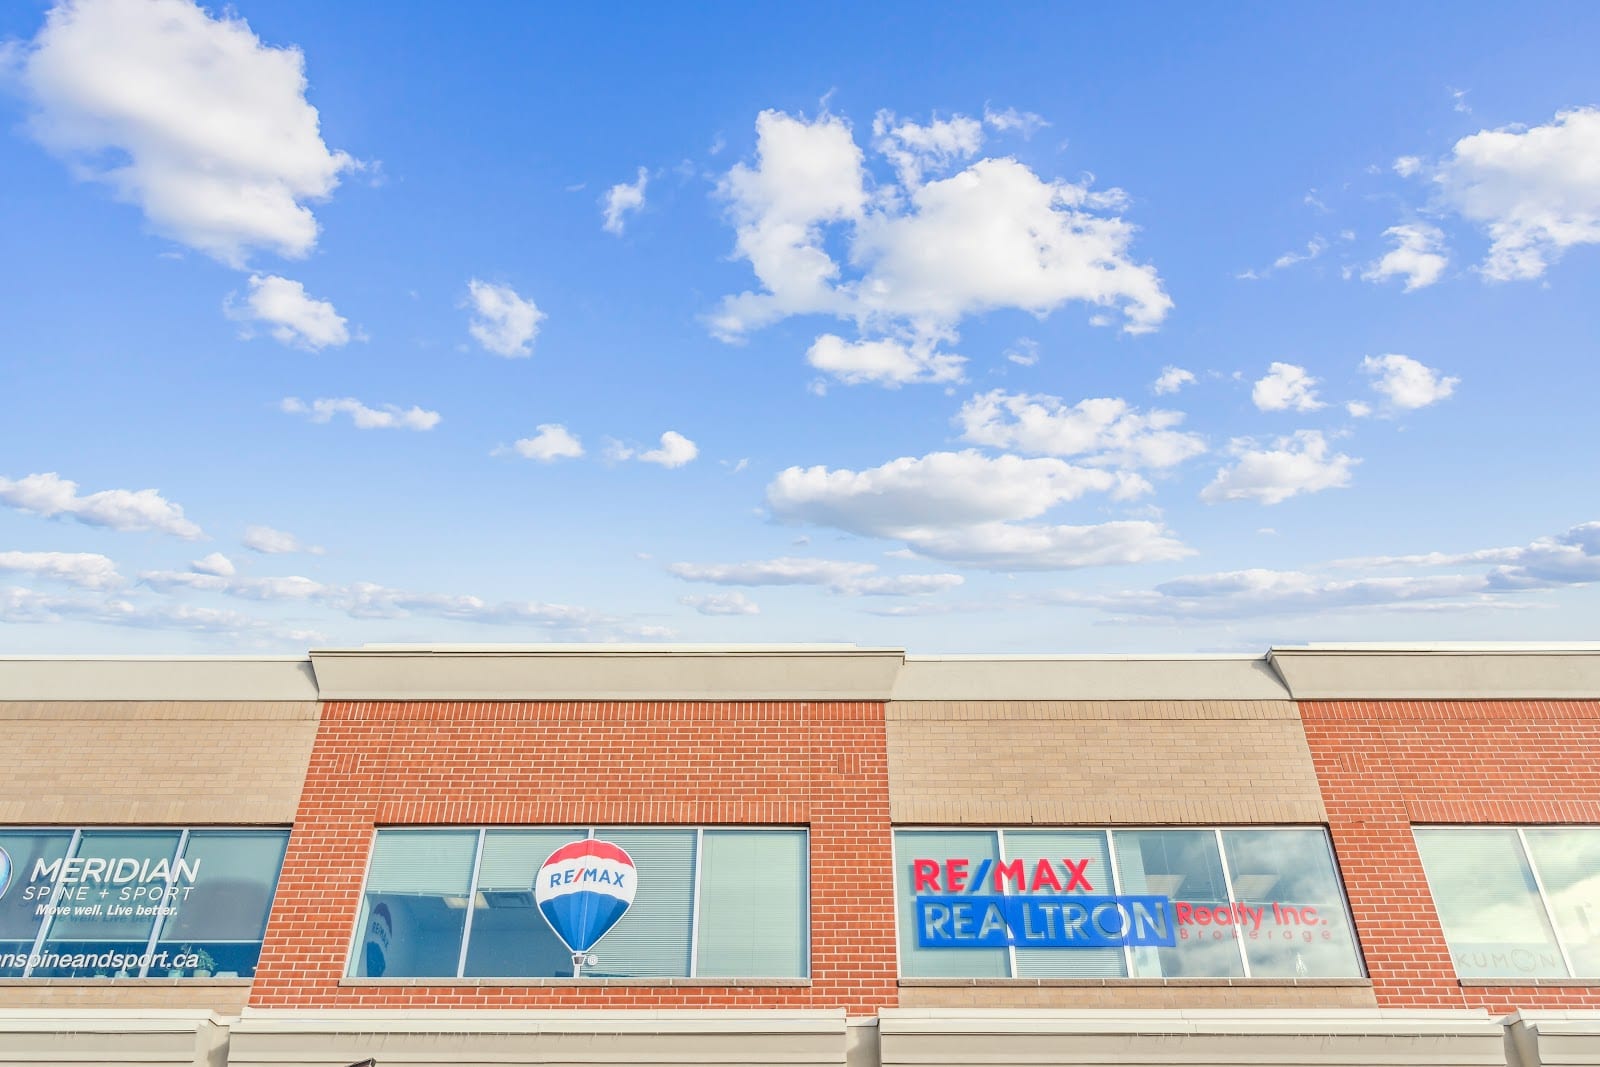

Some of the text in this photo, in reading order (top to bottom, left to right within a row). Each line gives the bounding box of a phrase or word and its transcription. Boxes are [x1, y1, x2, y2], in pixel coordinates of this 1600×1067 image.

[30, 857, 201, 883] MERIDIAN
[550, 868, 625, 888] RE/MAX
[913, 858, 1094, 893] RE/MAX
[22, 886, 90, 901] SPNE
[119, 886, 195, 901] SPORT
[35, 904, 178, 916] Move well. Live better.
[924, 902, 1169, 940] REALTRON
[1175, 901, 1329, 931] Realty Inc.
[1179, 928, 1332, 943] Brokerage
[0, 949, 199, 975] nspineandsport.ca
[1456, 949, 1556, 972] KUMON
